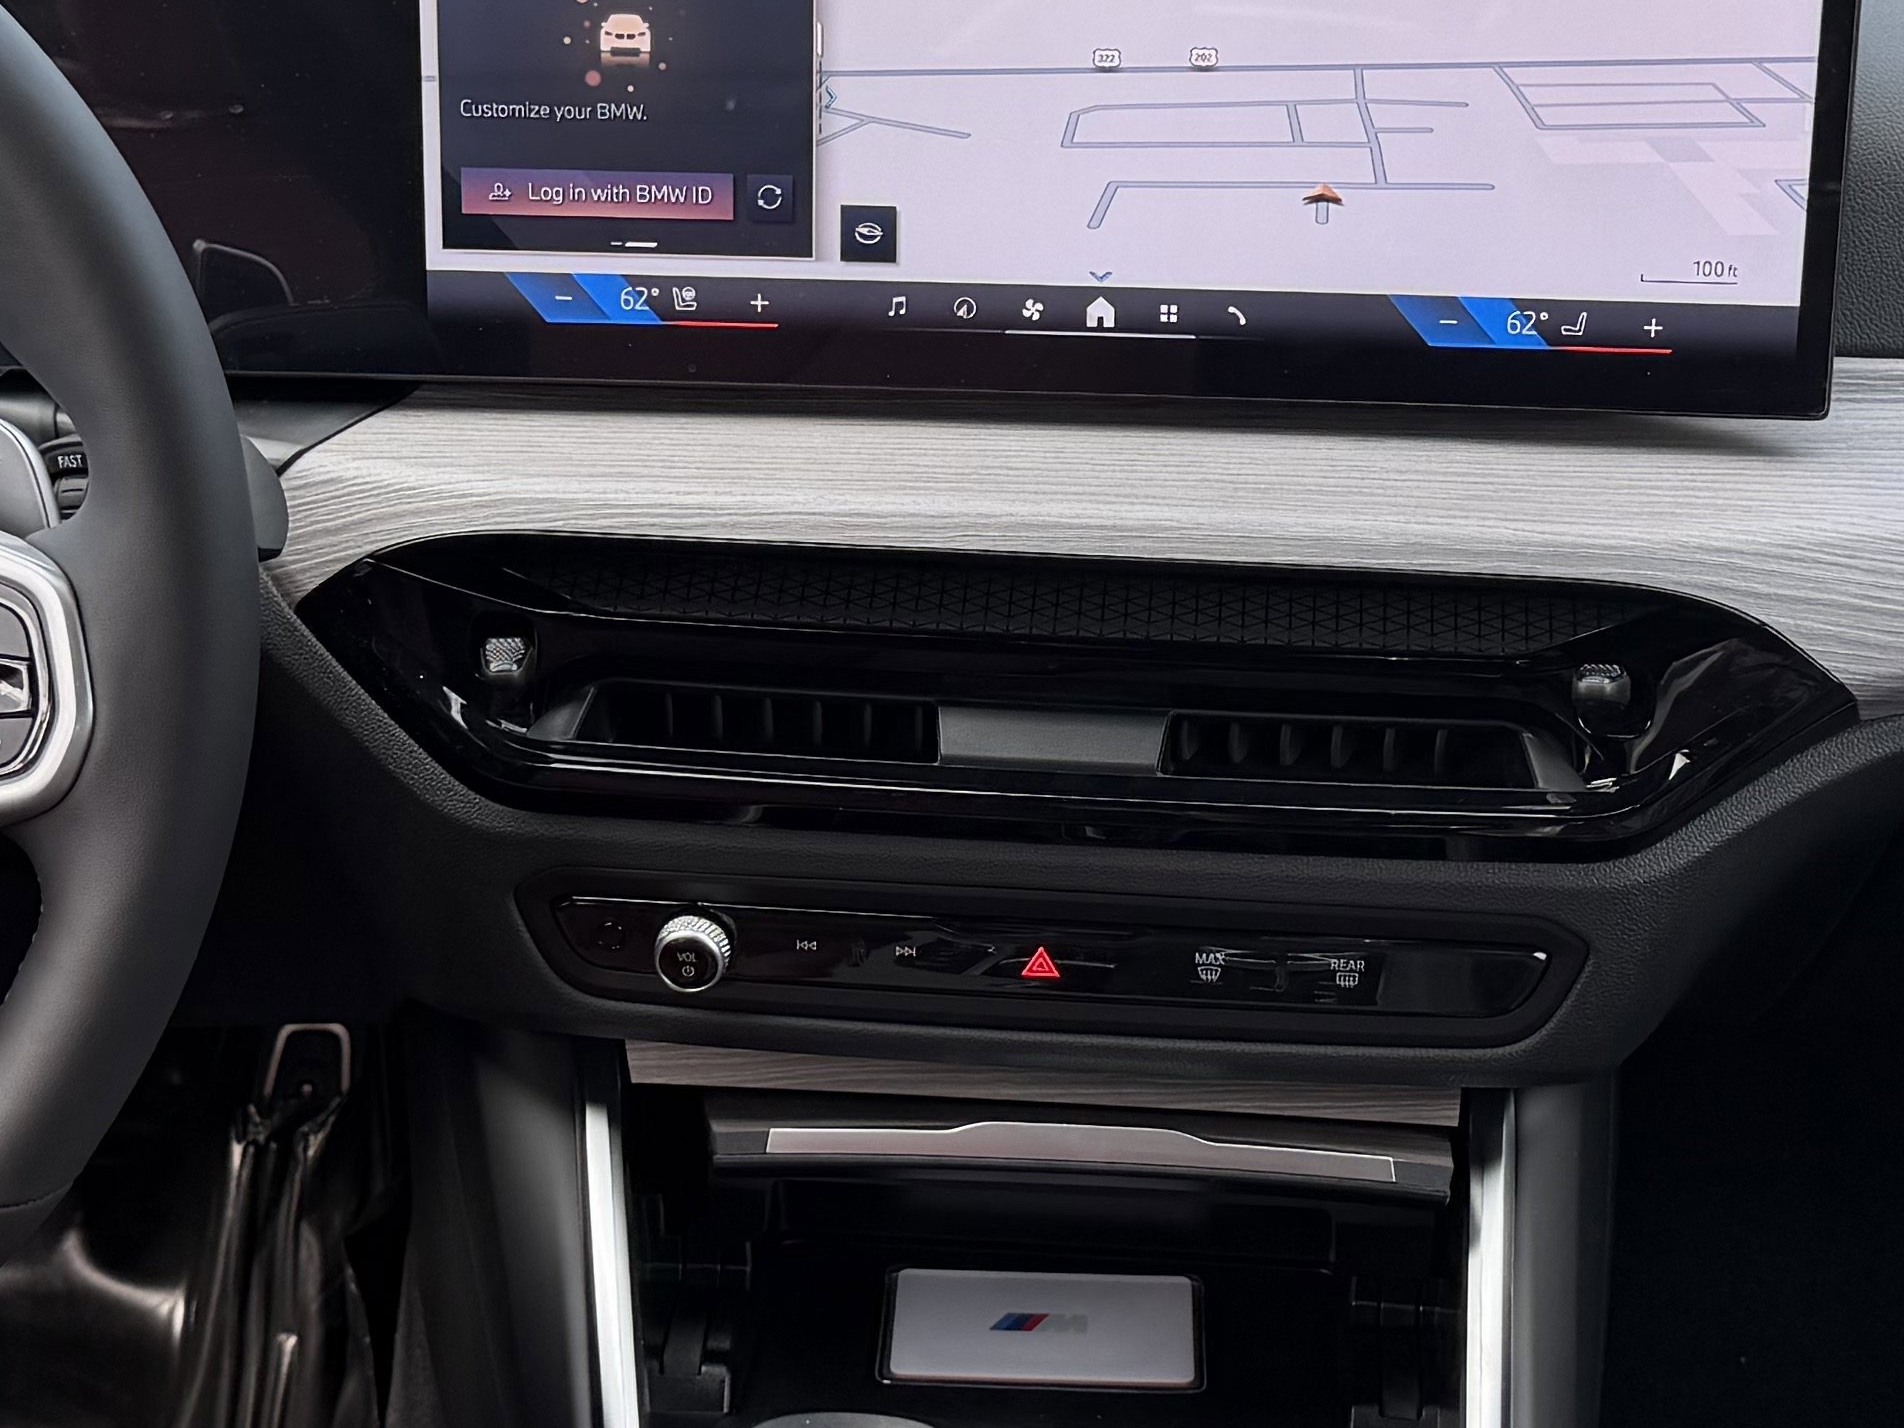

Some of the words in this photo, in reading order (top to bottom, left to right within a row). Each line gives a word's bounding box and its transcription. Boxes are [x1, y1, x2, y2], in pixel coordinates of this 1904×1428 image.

[459, 99, 550, 119] Customize
[554, 105, 592, 123] your
[596, 102, 648, 121] BMW.
[527, 183, 563, 206] Log
[569, 183, 586, 202] in
[592, 184, 630, 203] with
[636, 185, 687, 204] BMW
[692, 185, 713, 205] ID
[1692, 260, 1725, 278] 100
[1727, 264, 1738, 278] ft
[620, 286, 660, 310] 62°
[1505, 310, 1549, 335] 62°
[57, 454, 84, 469] FAST
[676, 951, 698, 963] VOL
[1194, 951, 1226, 966] MAX
[1330, 958, 1365, 972] REAR
